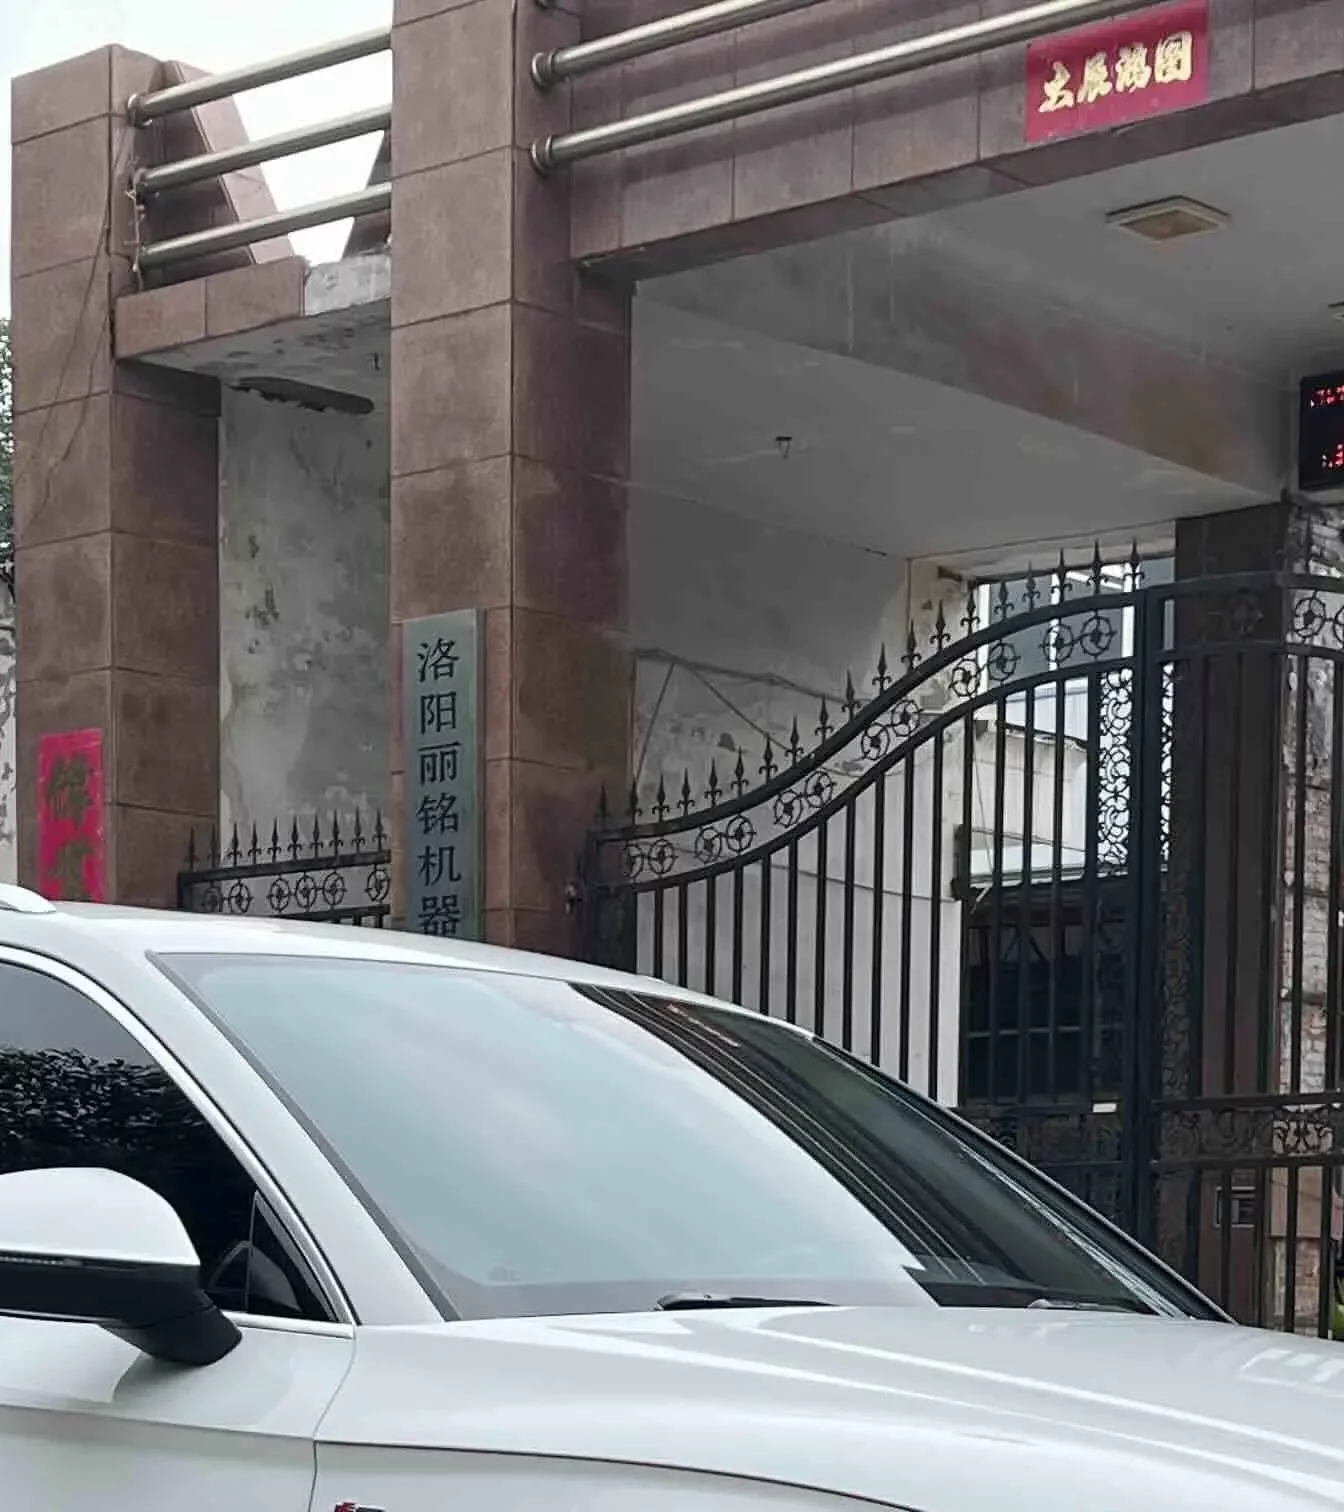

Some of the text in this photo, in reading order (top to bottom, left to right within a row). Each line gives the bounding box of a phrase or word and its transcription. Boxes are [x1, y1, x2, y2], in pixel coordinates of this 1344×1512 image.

[416, 637, 462, 937] 洛阳丽铭机器
